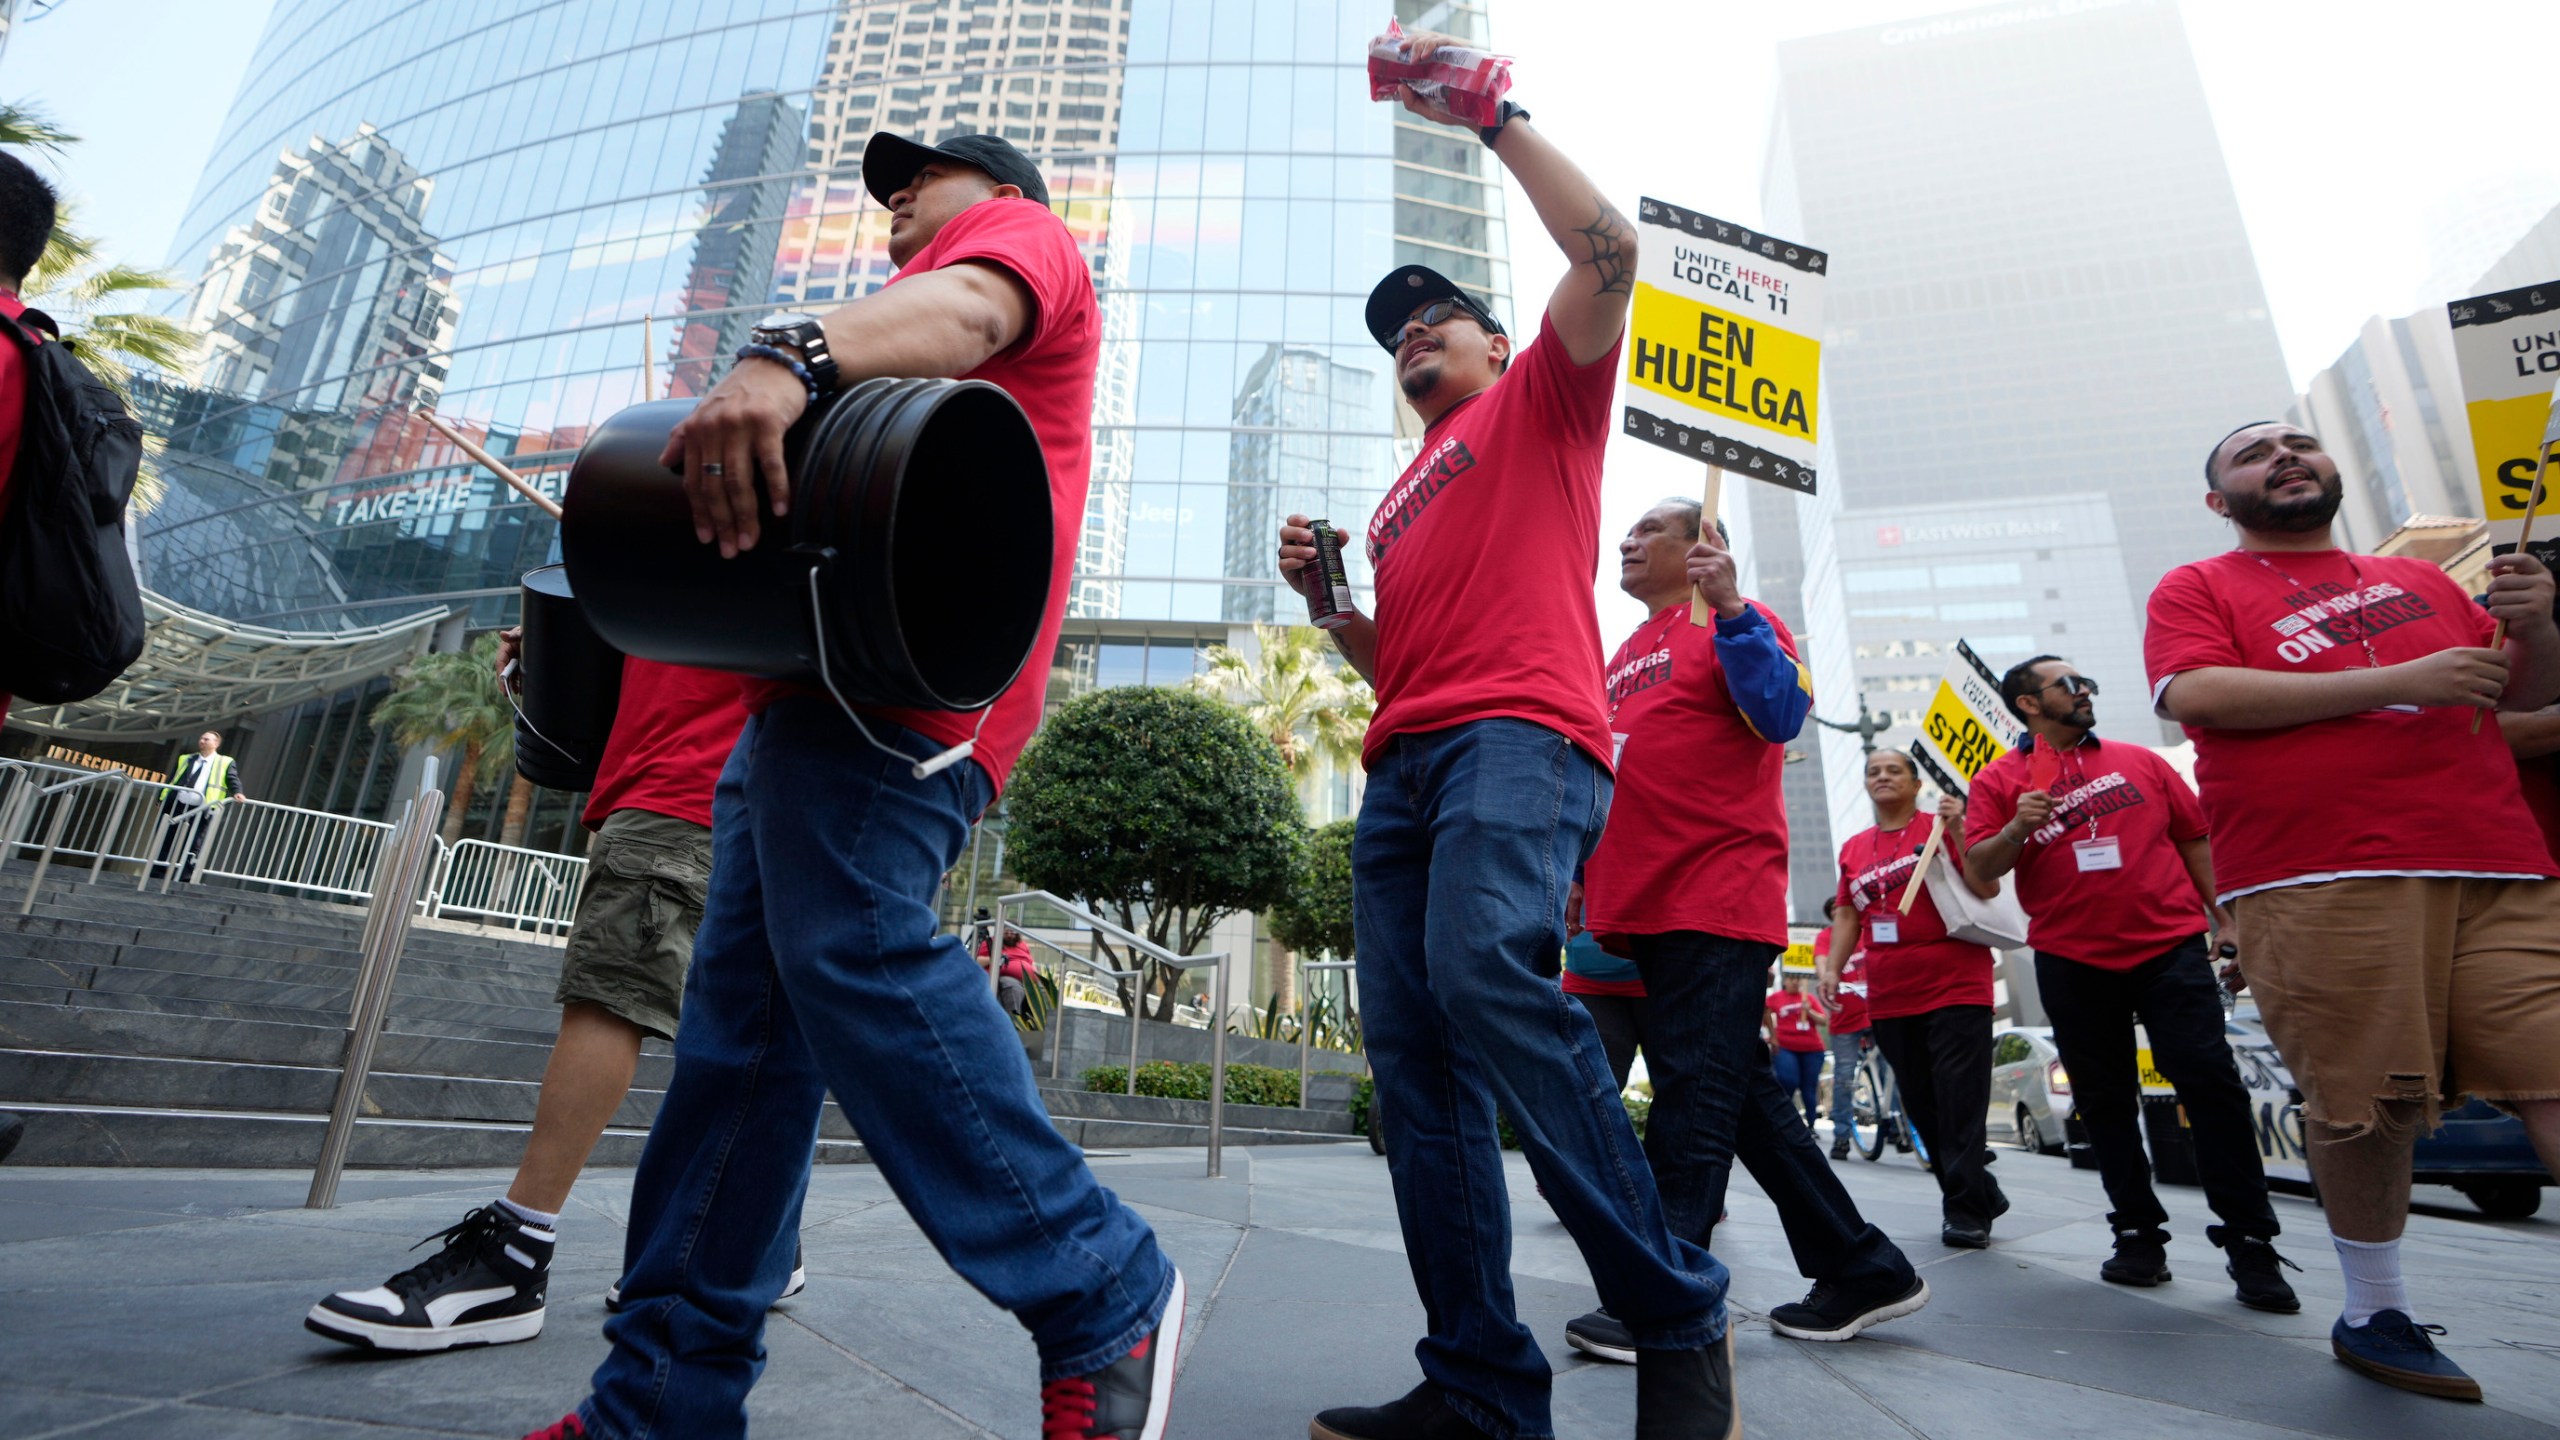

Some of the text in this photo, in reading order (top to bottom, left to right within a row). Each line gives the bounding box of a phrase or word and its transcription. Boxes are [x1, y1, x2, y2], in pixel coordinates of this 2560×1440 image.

[1673, 261, 1788, 315] LOCAL 11
[1675, 245, 1789, 297] UNITE HERE!
[1698, 312, 1754, 368] EN
[2512, 331, 2560, 354] UN
[1635, 337, 1809, 434] HUELGA
[2515, 351, 2560, 377] LO
[336, 470, 568, 526] TAKE THE VIE
[1131, 501, 1193, 527] Jeep
[1378, 446, 1474, 555] STRIKE
[2007, 519, 2065, 537] BANK
[2282, 581, 2353, 610] HOTEL
[2298, 582, 2404, 624] WORKERS
[2276, 591, 2437, 664] ON STRIKE
[1606, 648, 1671, 690] ORKERS
[1929, 712, 1986, 780] STRI
[1962, 718, 1996, 764] ON
[2034, 784, 2143, 845] ON STRIKE
[2054, 772, 2126, 814] WORKERS
[1784, 955, 1815, 967] HUEL
